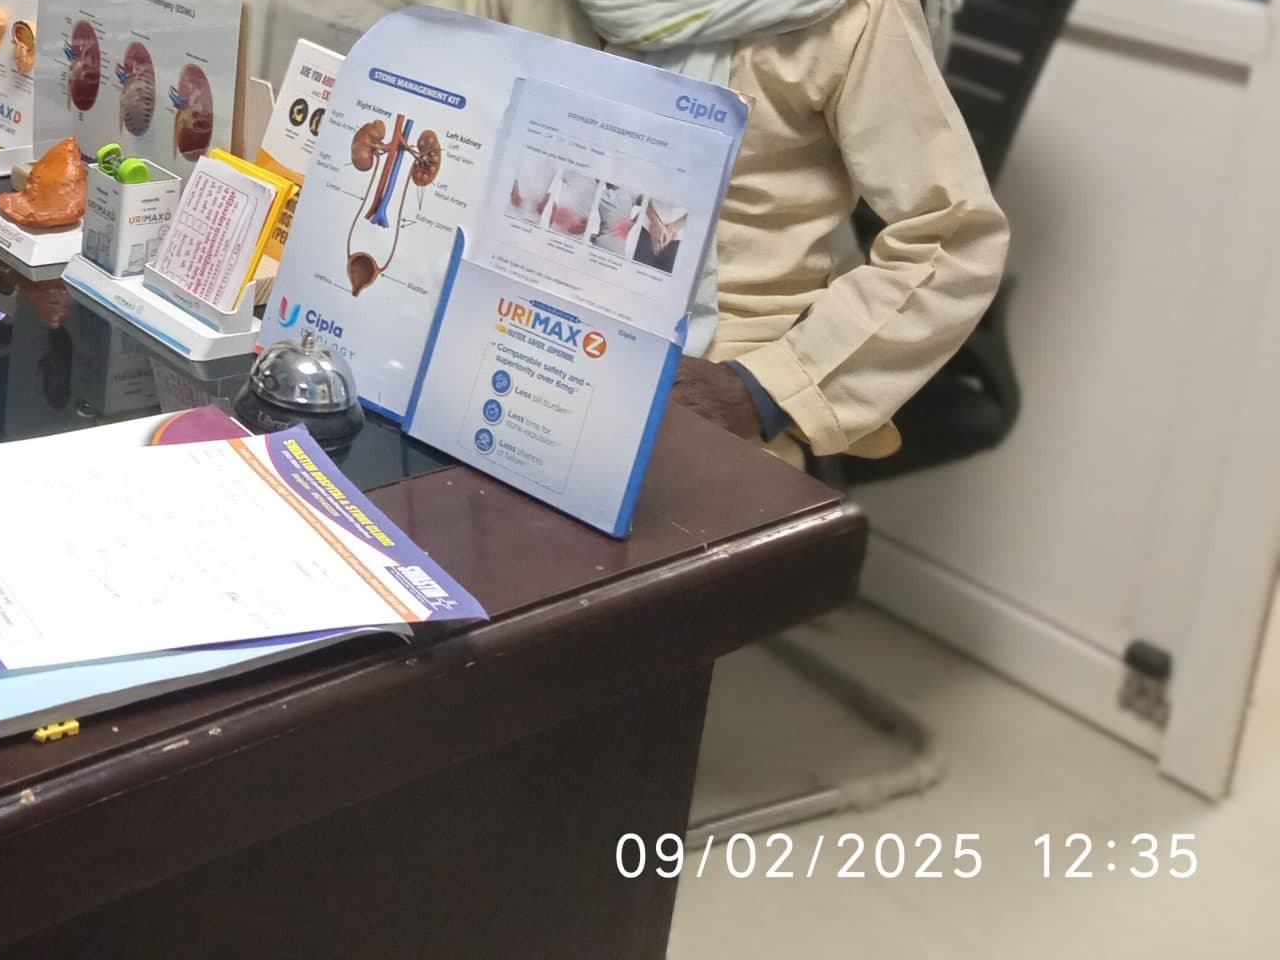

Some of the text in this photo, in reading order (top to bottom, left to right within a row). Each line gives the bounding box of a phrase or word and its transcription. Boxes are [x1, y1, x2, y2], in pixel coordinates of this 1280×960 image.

[397, 77, 447, 104] MANAGEMENT
[447, 94, 463, 107] KIT
[13, 111, 21, 124] D
[372, 105, 392, 119] kidney
[675, 95, 728, 124] Cipla
[446, 131, 482, 151] Left kidney
[599, 122, 646, 143] ASSESSMENT
[129, 213, 164, 225] URIMAX
[305, 308, 344, 339] Cipla
[497, 297, 582, 347] URIMAX
[496, 355, 536, 379] superiority
[536, 372, 554, 386] over
[497, 343, 585, 387] Comparable safety and
[514, 386, 532, 400] Less
[507, 409, 524, 423] Less
[499, 439, 517, 453] Less
